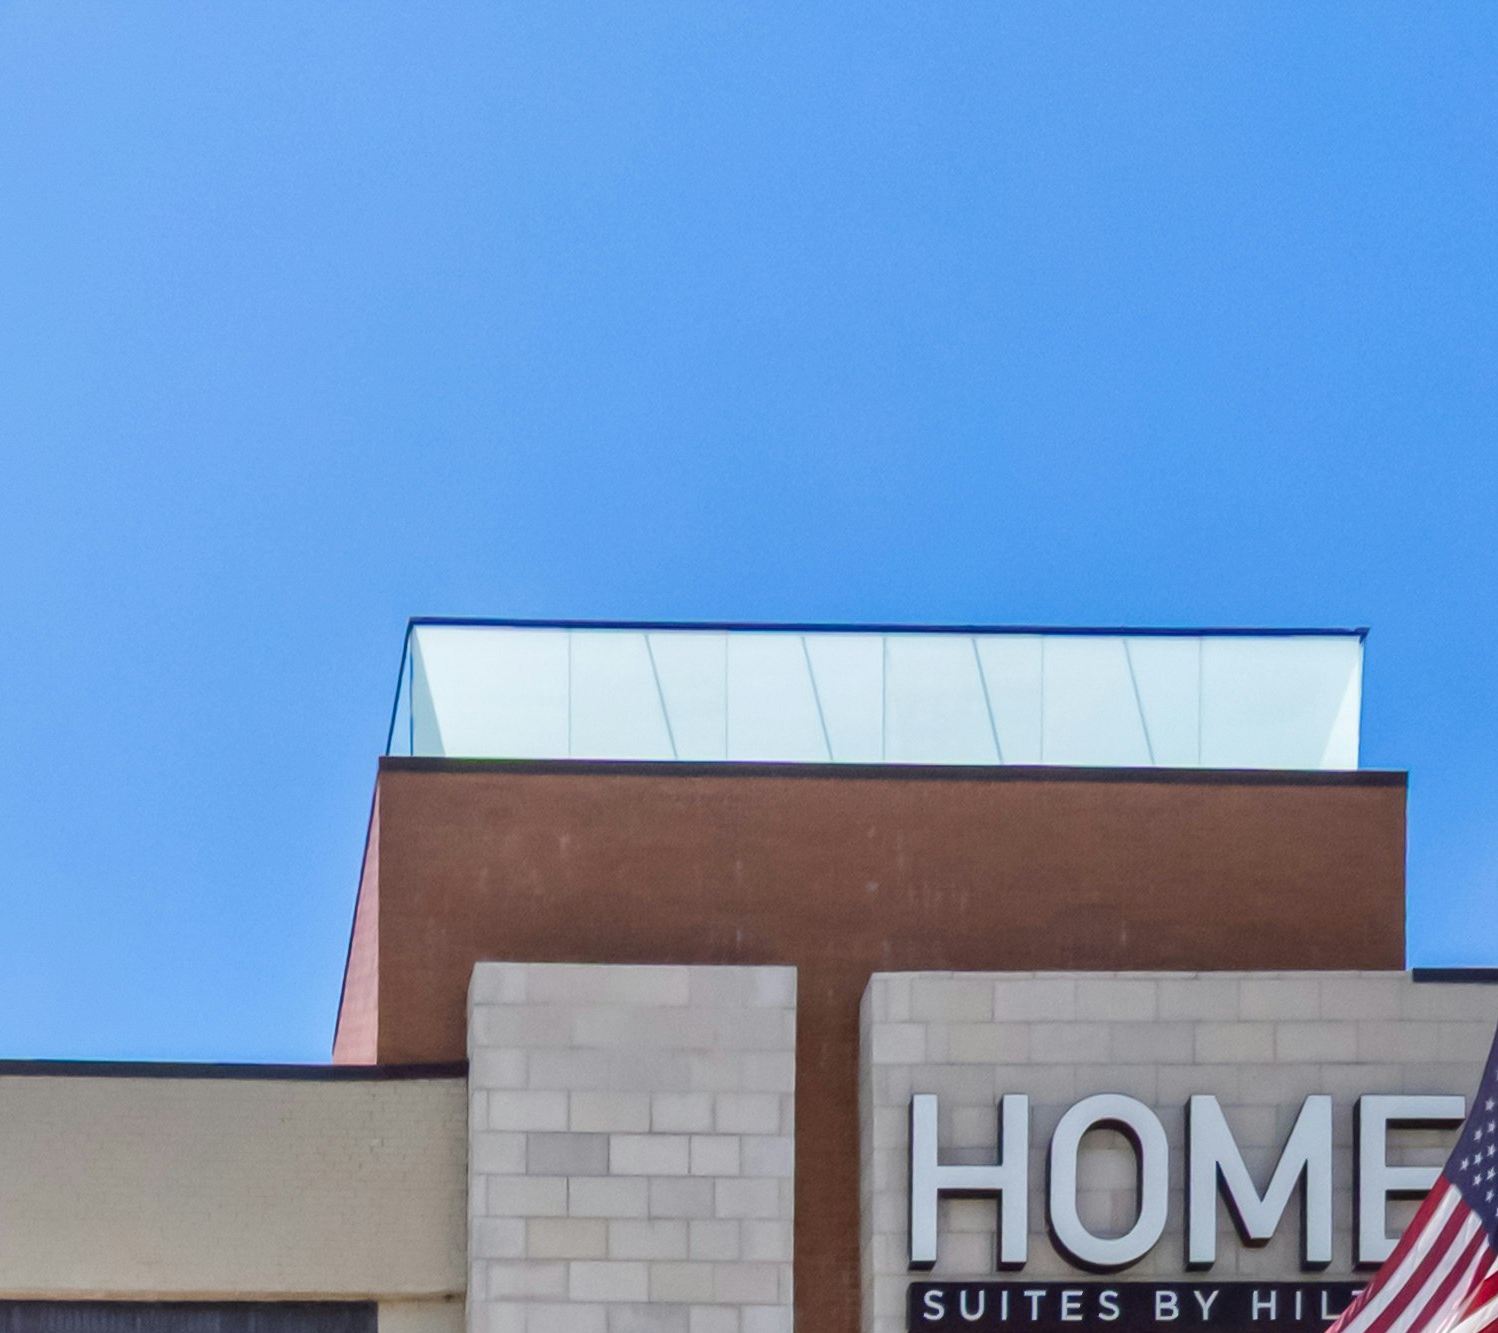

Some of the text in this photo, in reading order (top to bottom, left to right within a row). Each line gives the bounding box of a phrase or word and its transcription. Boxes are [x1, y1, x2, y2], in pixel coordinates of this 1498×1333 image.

[909, 1092, 1466, 1270] HOME
[922, 1288, 1367, 1323] SUITES BY HIL
